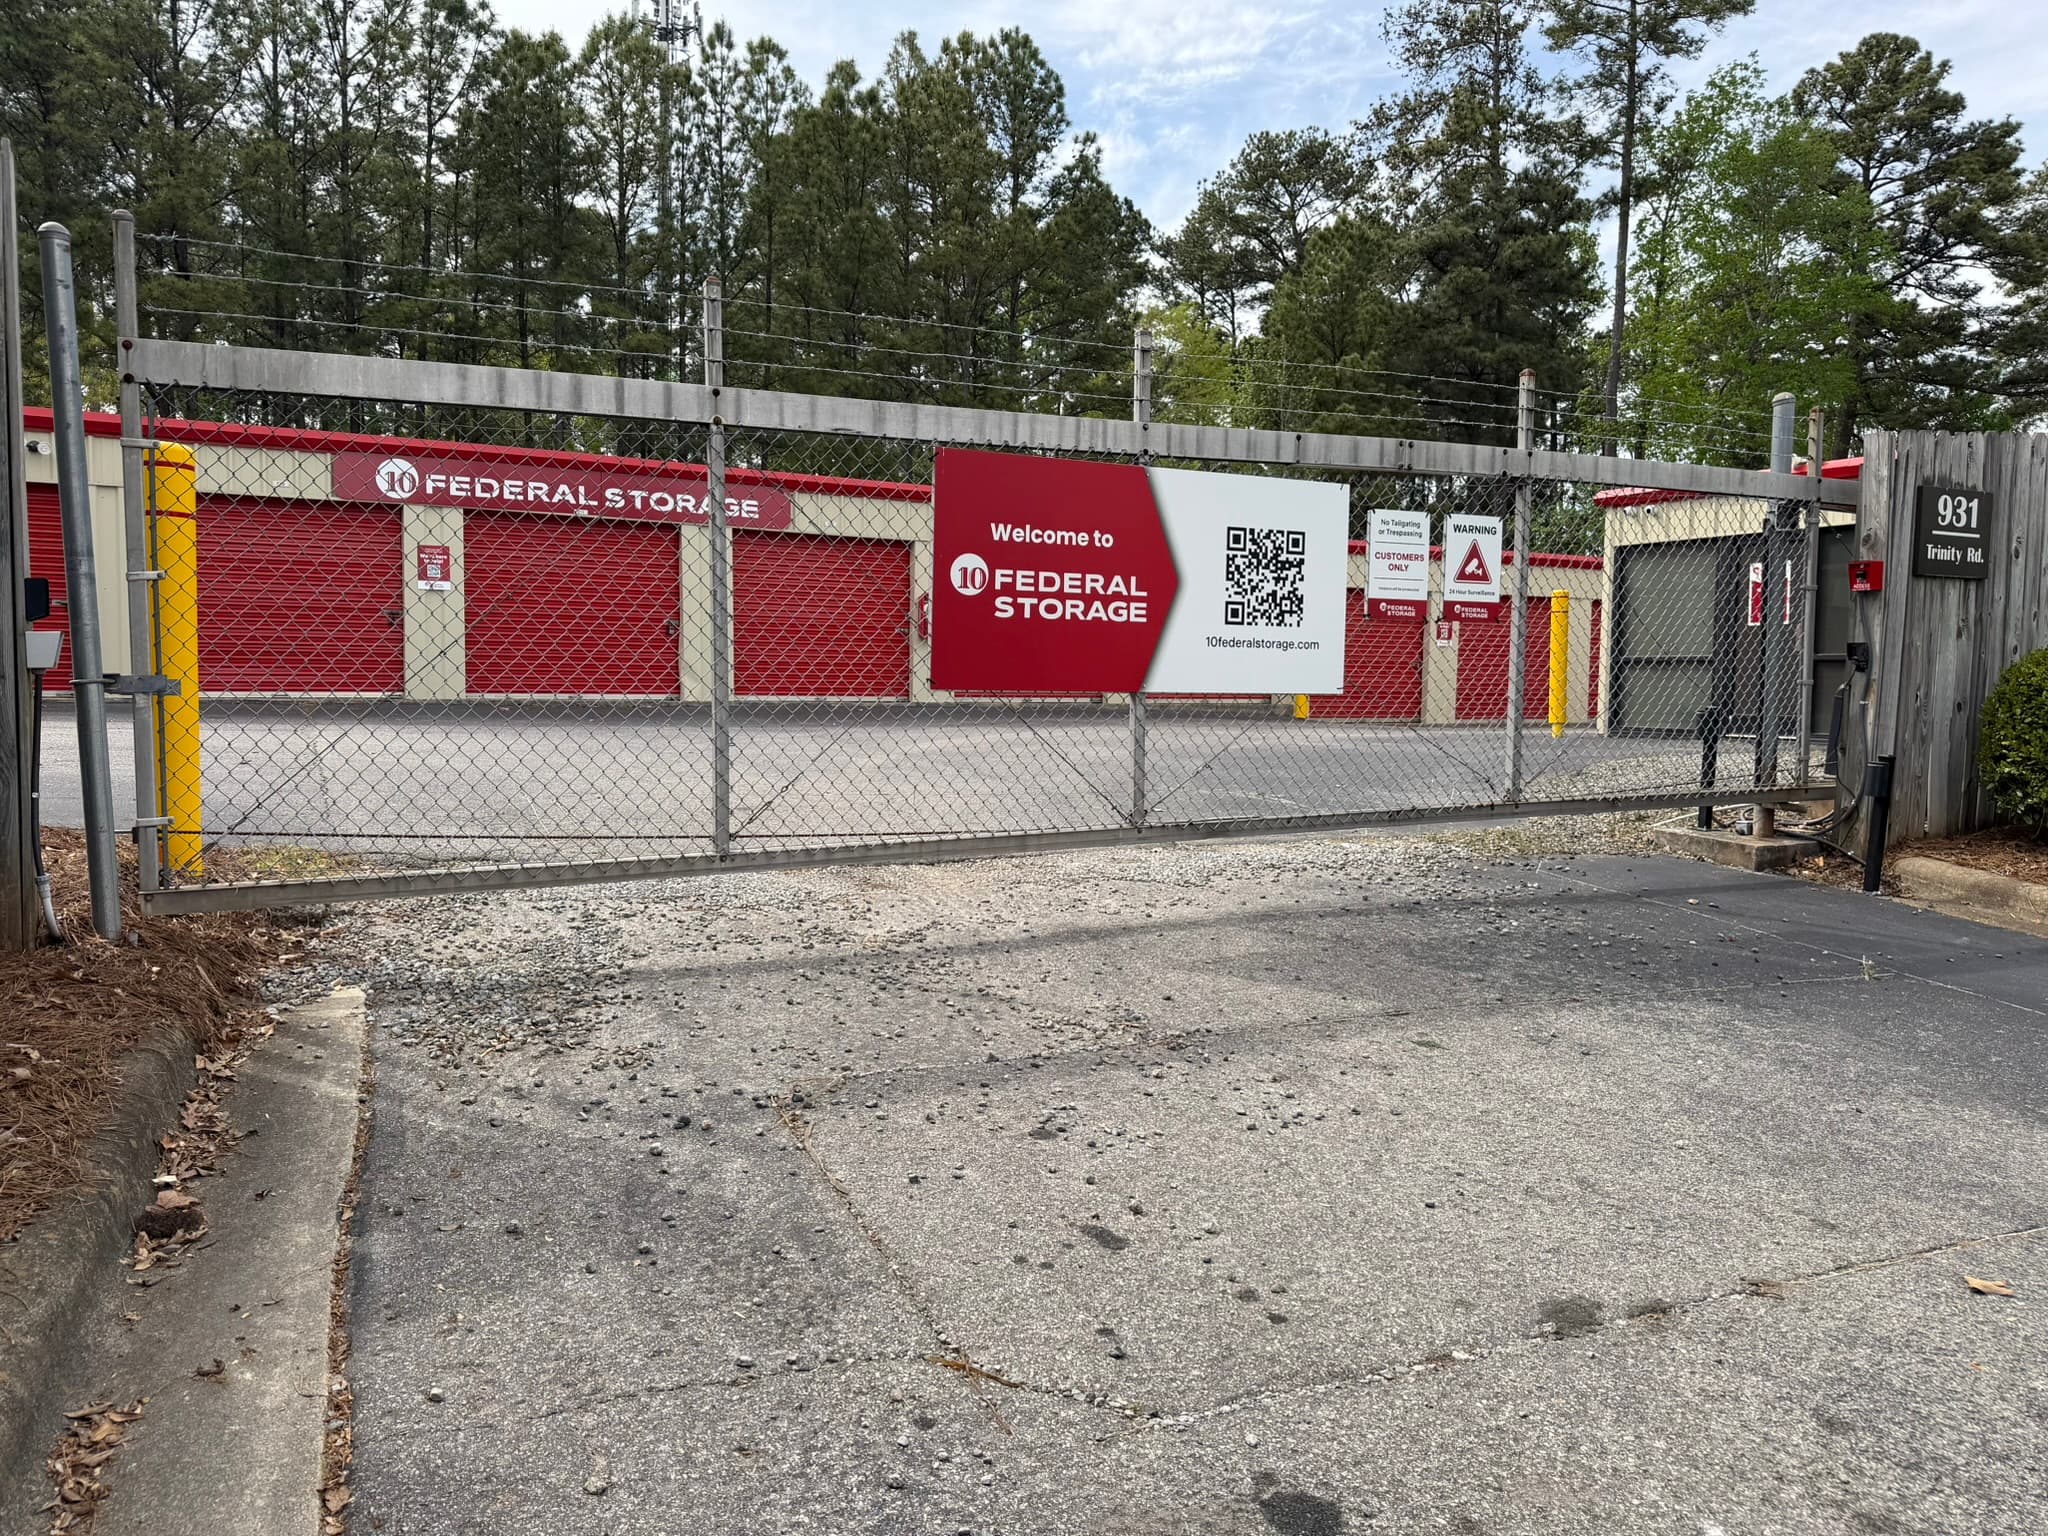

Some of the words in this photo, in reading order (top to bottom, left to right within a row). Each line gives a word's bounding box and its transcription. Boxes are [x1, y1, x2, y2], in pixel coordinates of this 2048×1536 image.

[425, 474, 599, 506] FEDERAL
[1937, 494, 1978, 529] 931
[1386, 528, 1423, 539] Trespassing
[1391, 519, 1421, 529] Tailgating
[1453, 523, 1497, 536] WARNING
[990, 522, 1089, 547] Welcome
[1093, 529, 1114, 548] to
[1374, 551, 1425, 562] CUSTOMERS
[1926, 543, 1964, 566] Trinity
[1967, 546, 1985, 564] Rd.
[1388, 563, 1409, 572] ONLY
[957, 566, 987, 590] 10
[994, 568, 1148, 597] FEDERAL
[994, 596, 1148, 623] STORAGE
[1206, 635, 1320, 652] 10federalstorage.com
